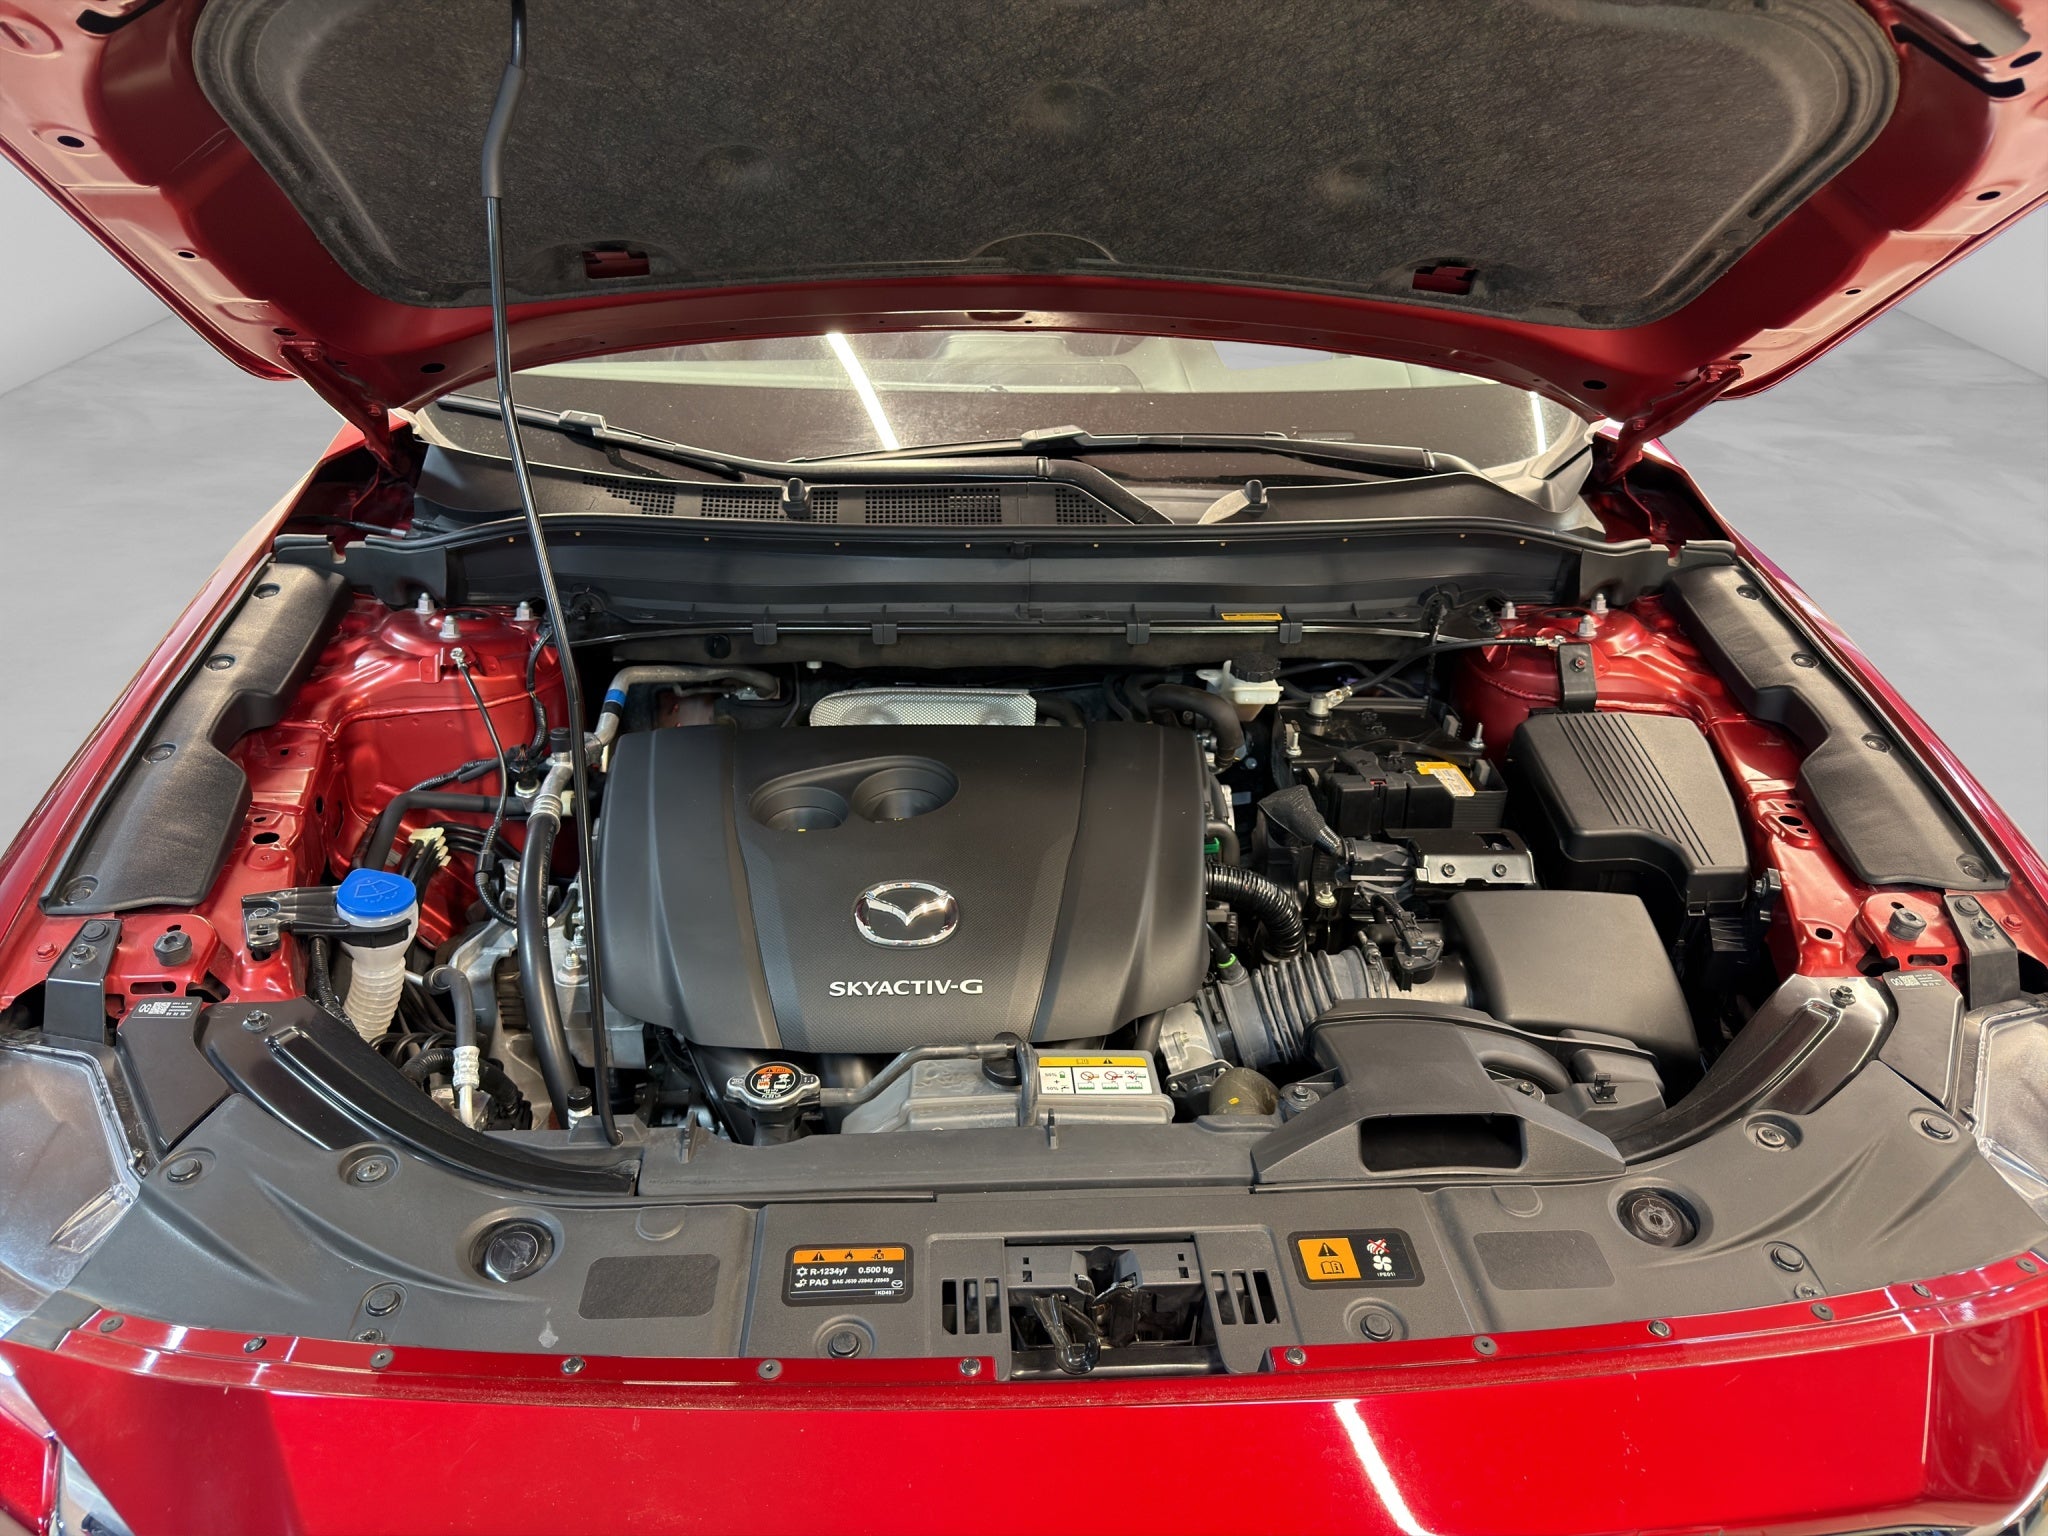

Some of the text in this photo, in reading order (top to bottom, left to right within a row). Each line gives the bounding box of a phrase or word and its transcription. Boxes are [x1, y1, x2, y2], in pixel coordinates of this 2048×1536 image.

[829, 979, 983, 997] SKYACTIV-G
[809, 1265, 894, 1277] R-1234yf 0.500 kg
[809, 1278, 829, 1287] PAG
